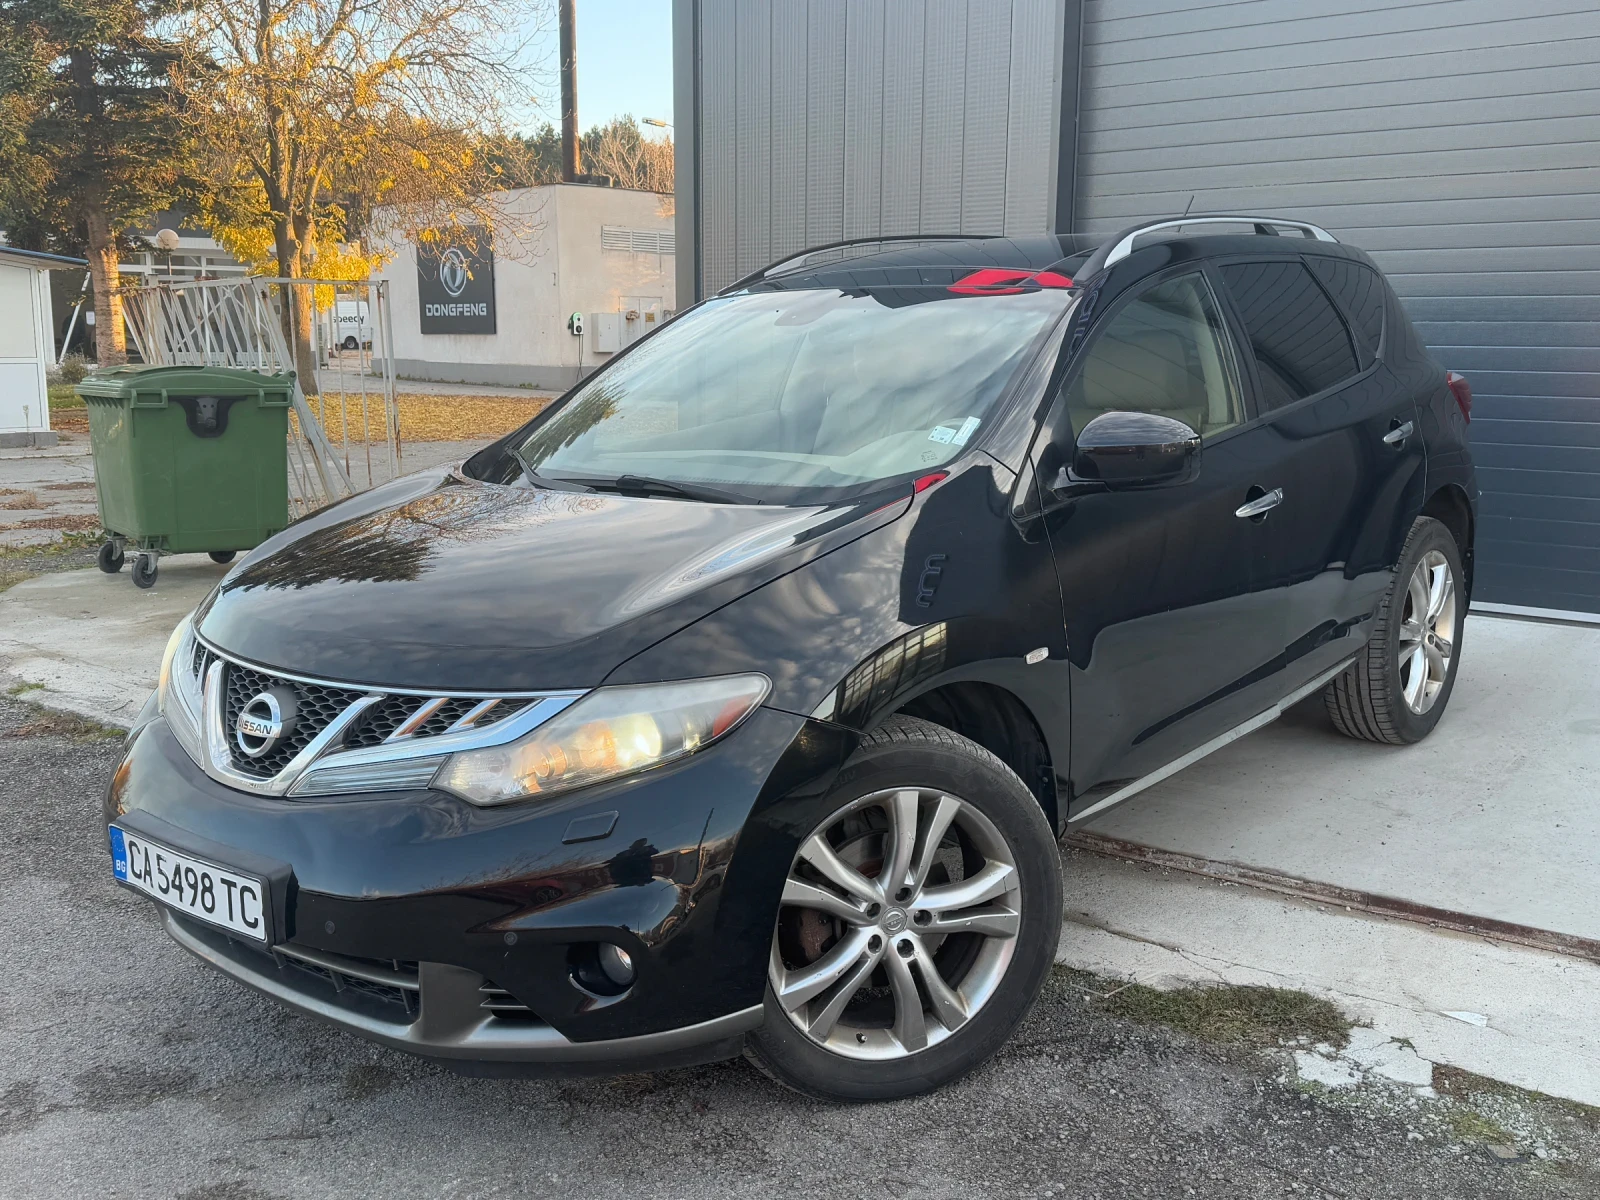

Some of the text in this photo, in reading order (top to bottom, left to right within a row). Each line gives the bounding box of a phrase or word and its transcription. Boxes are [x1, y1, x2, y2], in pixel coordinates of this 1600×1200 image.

[425, 303, 487, 316] DONGFENG
[238, 719, 273, 735] NISSAN
[115, 859, 127, 873] BG
[220, 878, 259, 929] TC
